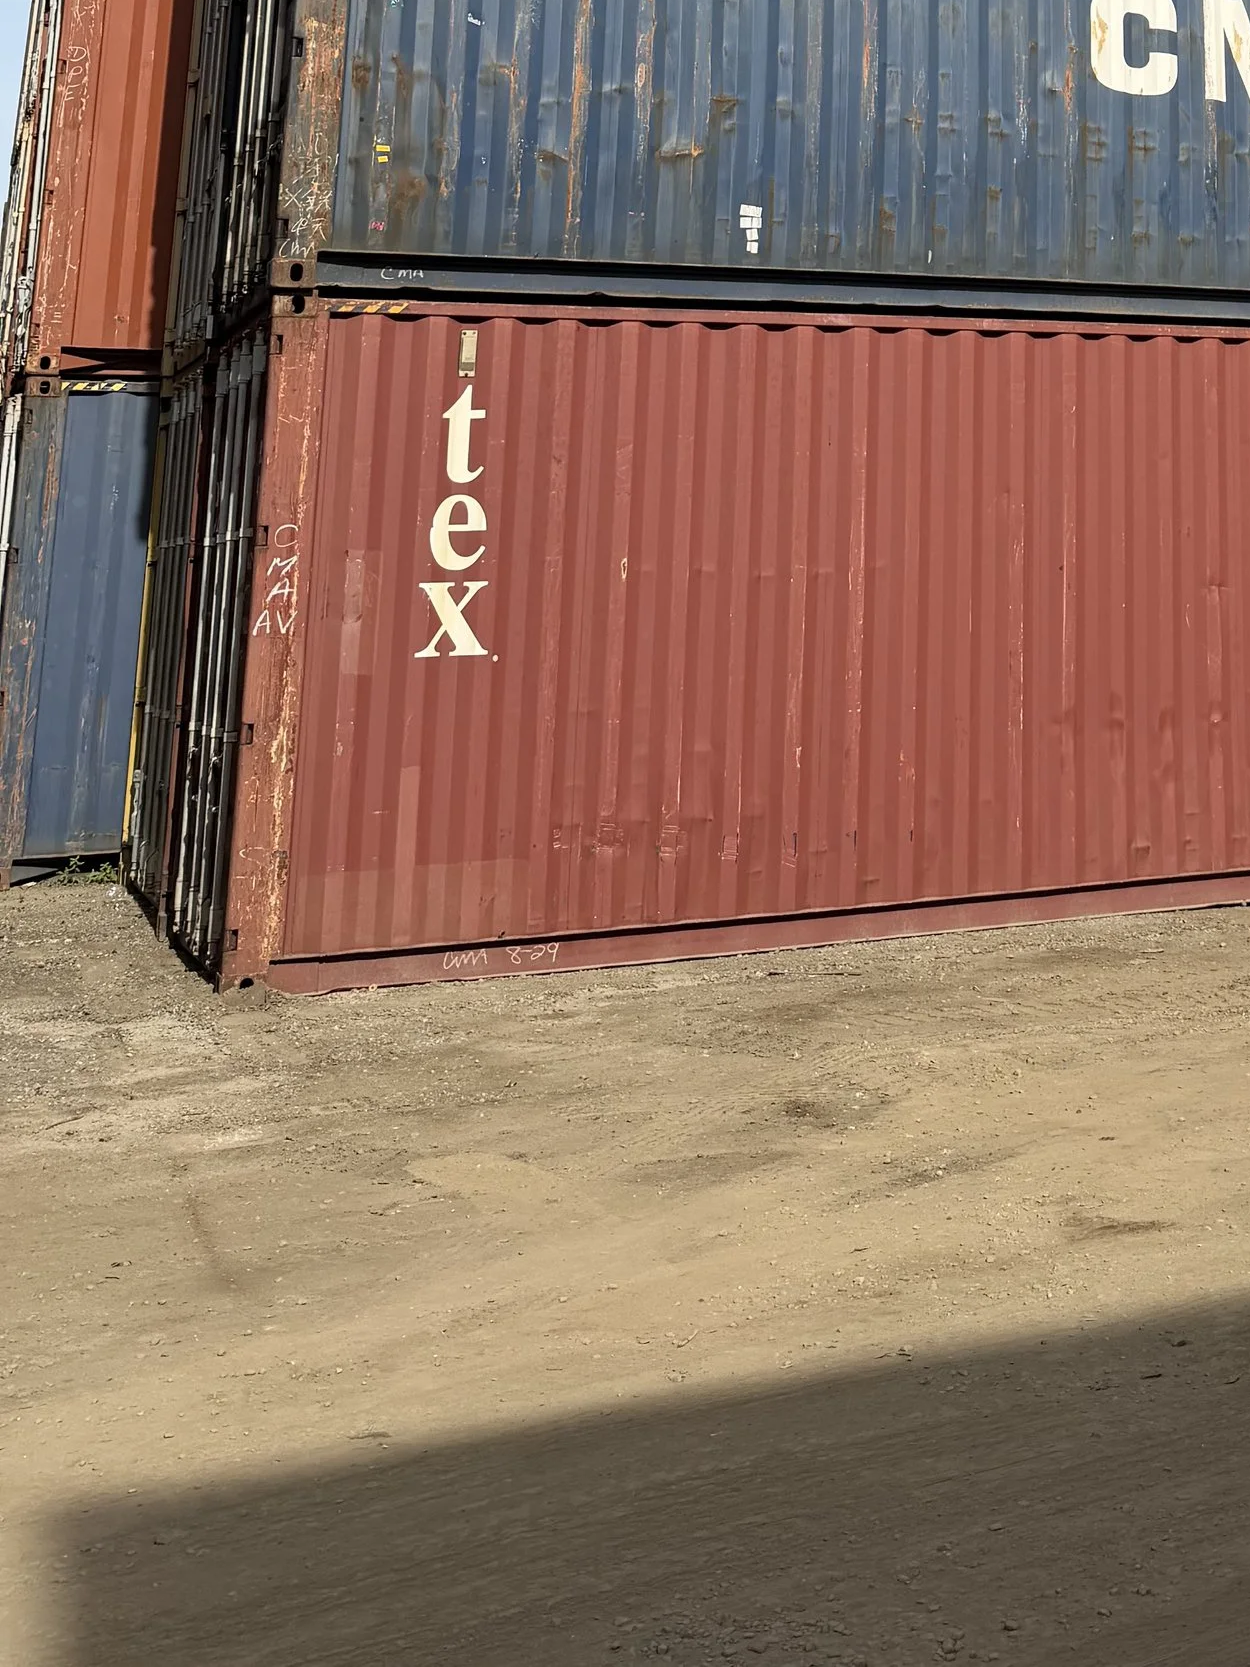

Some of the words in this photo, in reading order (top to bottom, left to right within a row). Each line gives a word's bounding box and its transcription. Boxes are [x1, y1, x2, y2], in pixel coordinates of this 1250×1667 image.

[380, 267, 424, 280] CMA
[252, 609, 298, 637] AV
[505, 942, 560, 965] 8-29
